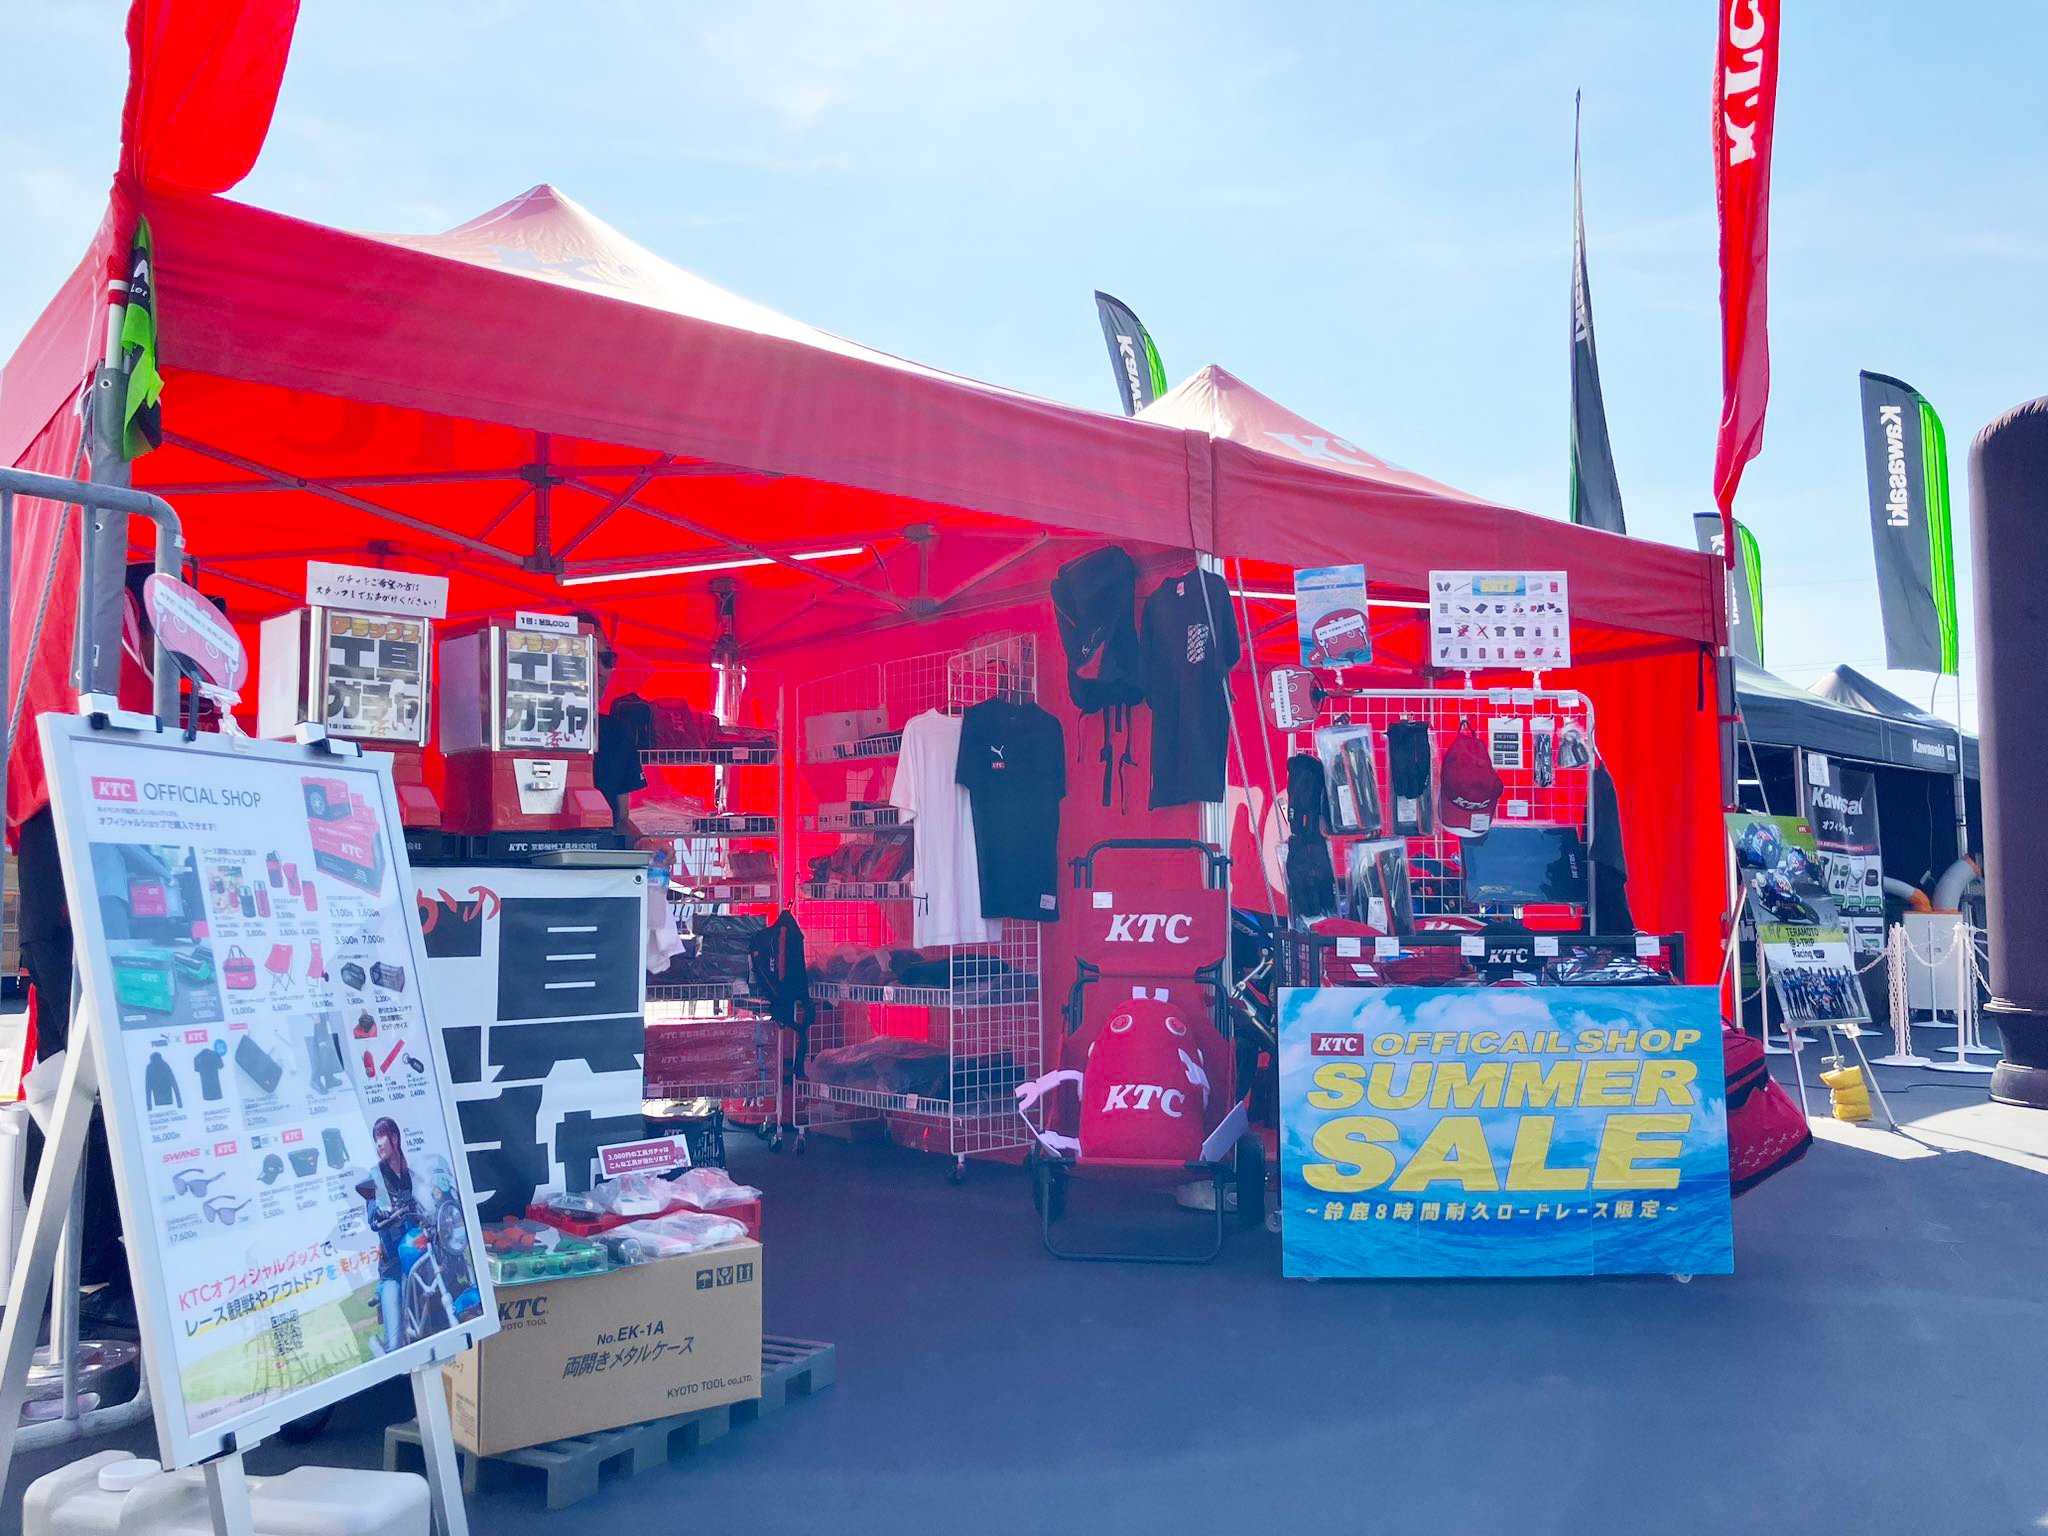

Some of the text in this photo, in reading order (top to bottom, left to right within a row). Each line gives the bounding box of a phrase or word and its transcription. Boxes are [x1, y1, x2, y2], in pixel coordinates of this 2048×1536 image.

[330, 635, 420, 685] 工具
[508, 651, 589, 697] 工具
[1912, 739, 1945, 759] Kawasaki
[100, 781, 261, 808] KTC OFFICIAL SHOP
[1450, 796, 1491, 810] KTC
[341, 842, 363, 859] KTC
[508, 842, 528, 852] KTC
[1104, 913, 1194, 944] KTC
[1784, 927, 1820, 938] TERAMOTO
[1487, 948, 1529, 964] KTC
[1791, 948, 1814, 960] Racing
[1316, 1029, 1702, 1057] KTC OFFICAIL SHOP
[1306, 1059, 1698, 1111] SUMMER
[1102, 1082, 1185, 1118] KTC
[162, 1148, 202, 1162] SWANS
[1302, 1113, 1691, 1194] SALE
[498, 1296, 548, 1322] KTC
[501, 1318, 548, 1332] YOTO TOOL
[562, 1336, 695, 1380] 両開きメタルケース
[667, 1384, 699, 1400] KYOTO
[702, 1378, 725, 1392] TOOL
